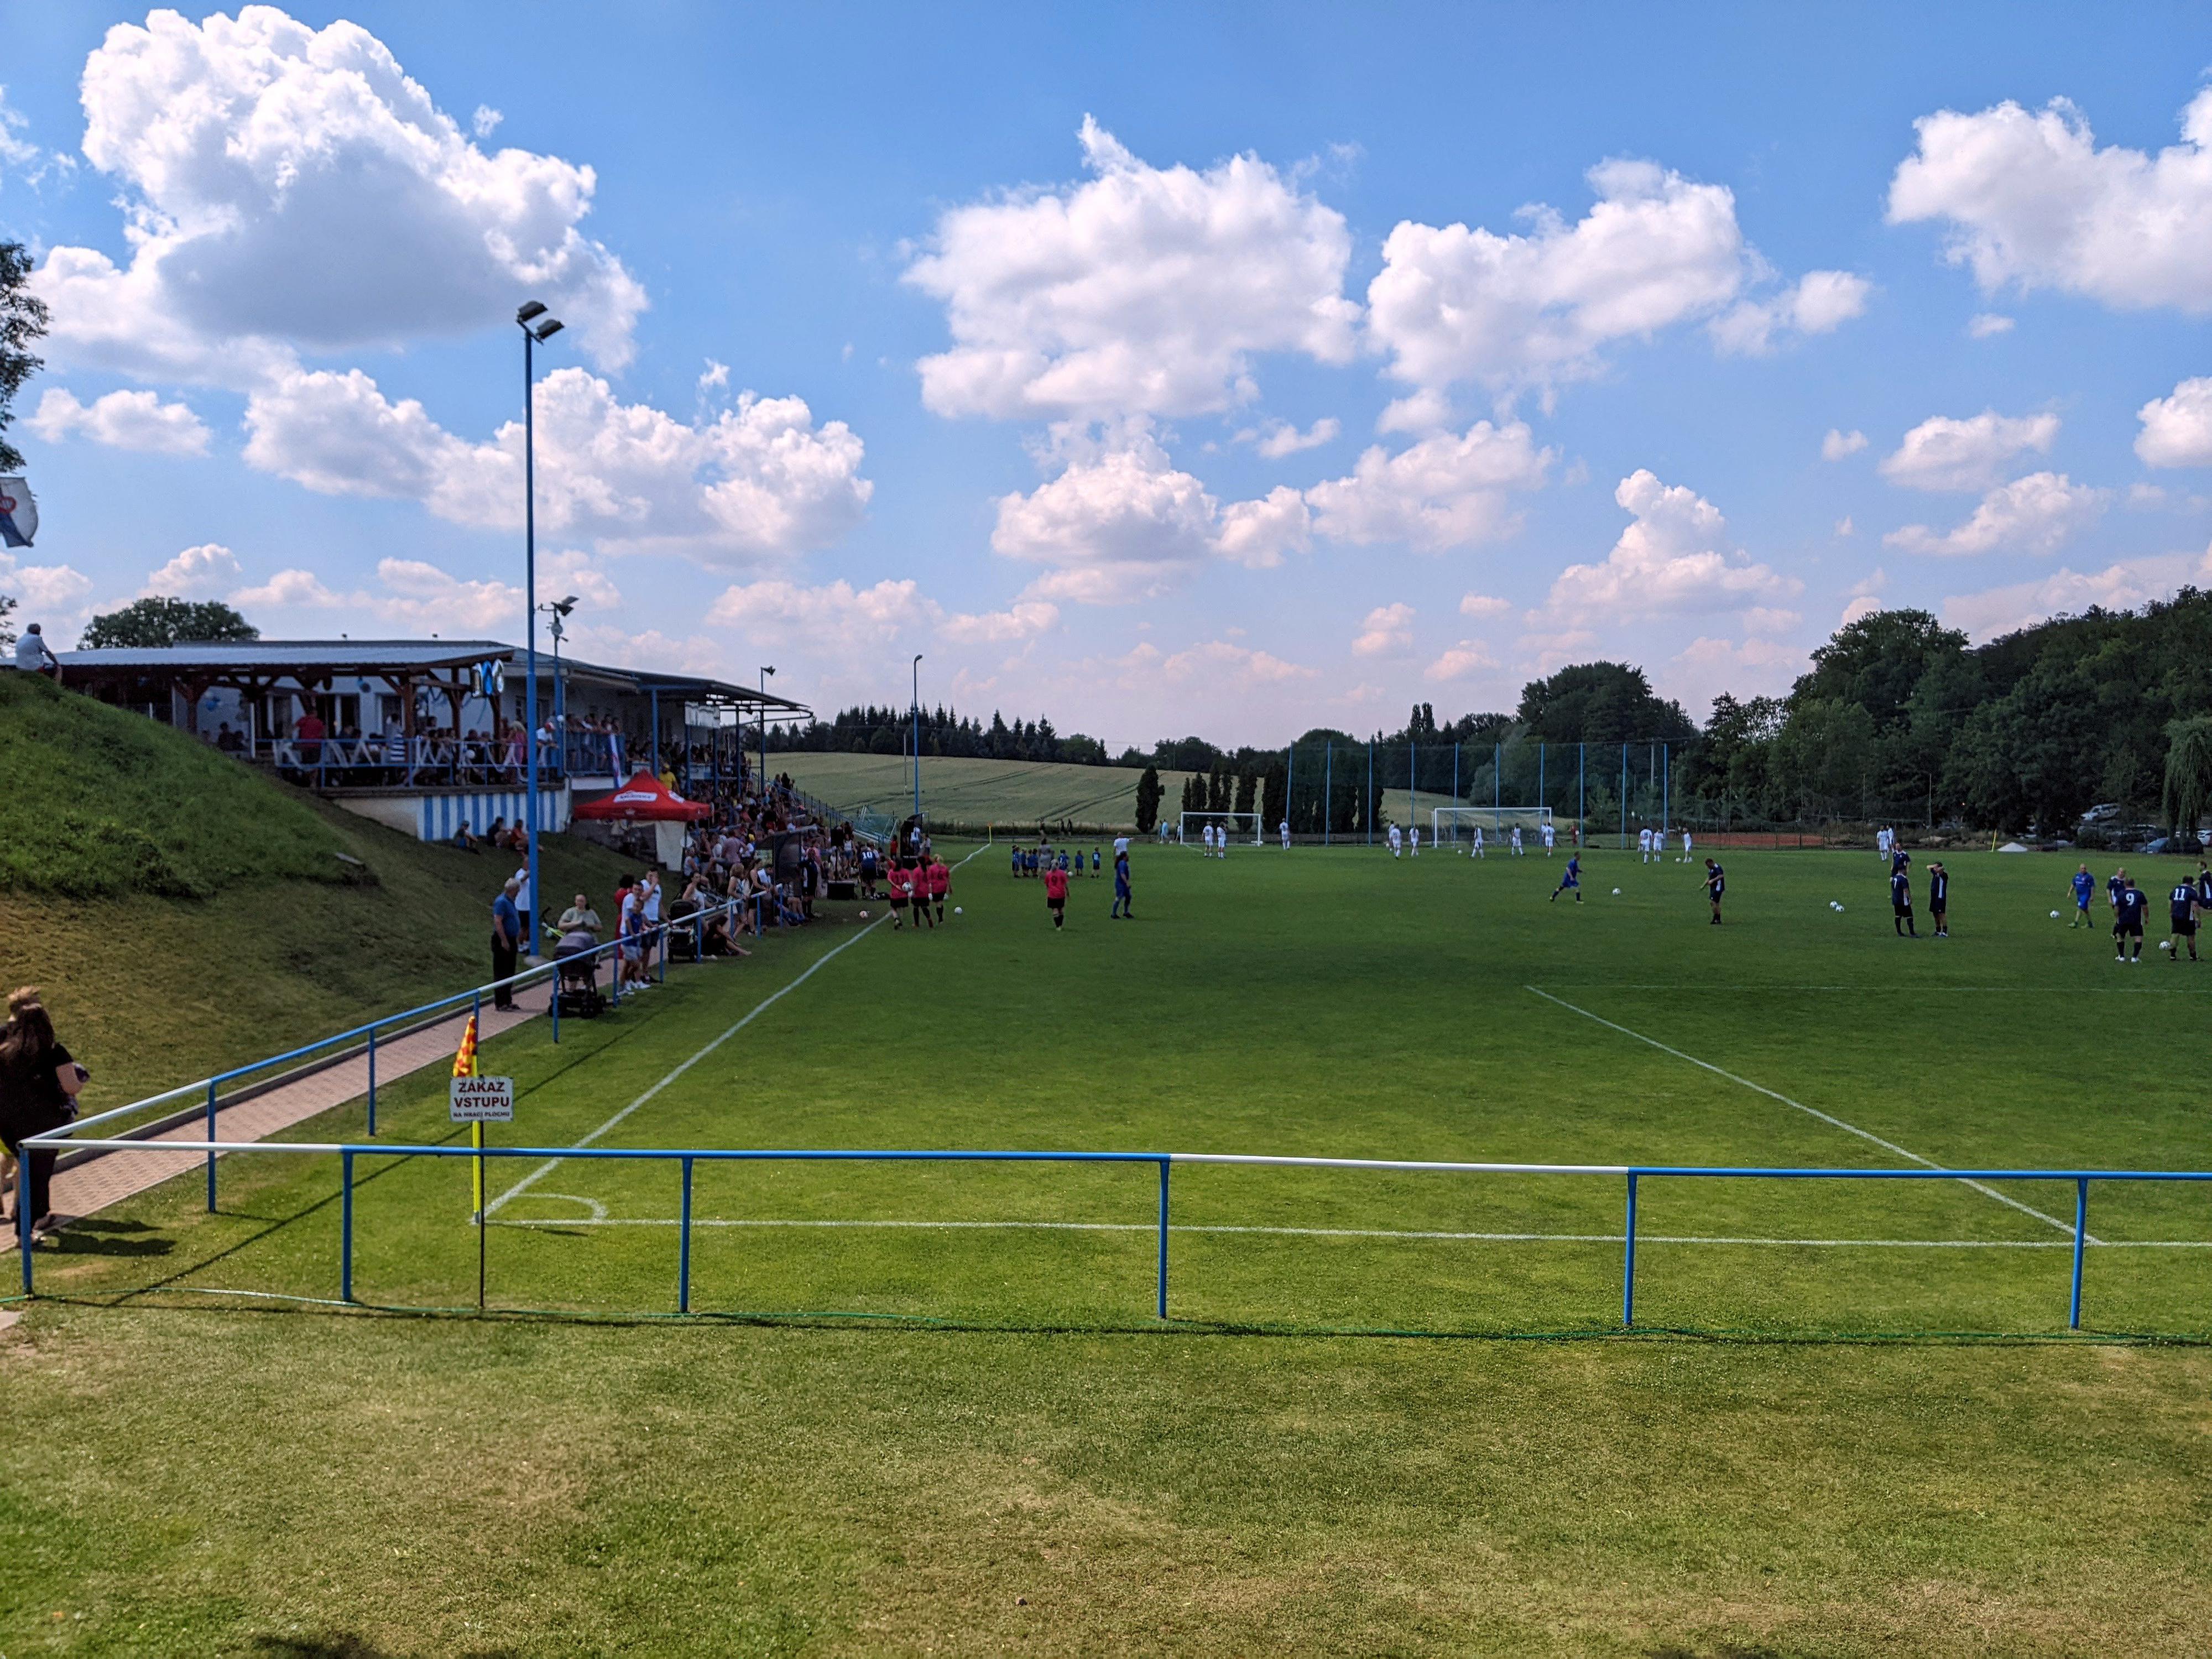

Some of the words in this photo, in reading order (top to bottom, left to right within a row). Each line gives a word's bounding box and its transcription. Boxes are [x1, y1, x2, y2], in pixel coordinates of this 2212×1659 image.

[1894, 878, 1897, 889] 7
[2126, 893, 2134, 905] 9
[2173, 888, 2185, 900] 11
[453, 1097, 509, 1108] VSTUPU
